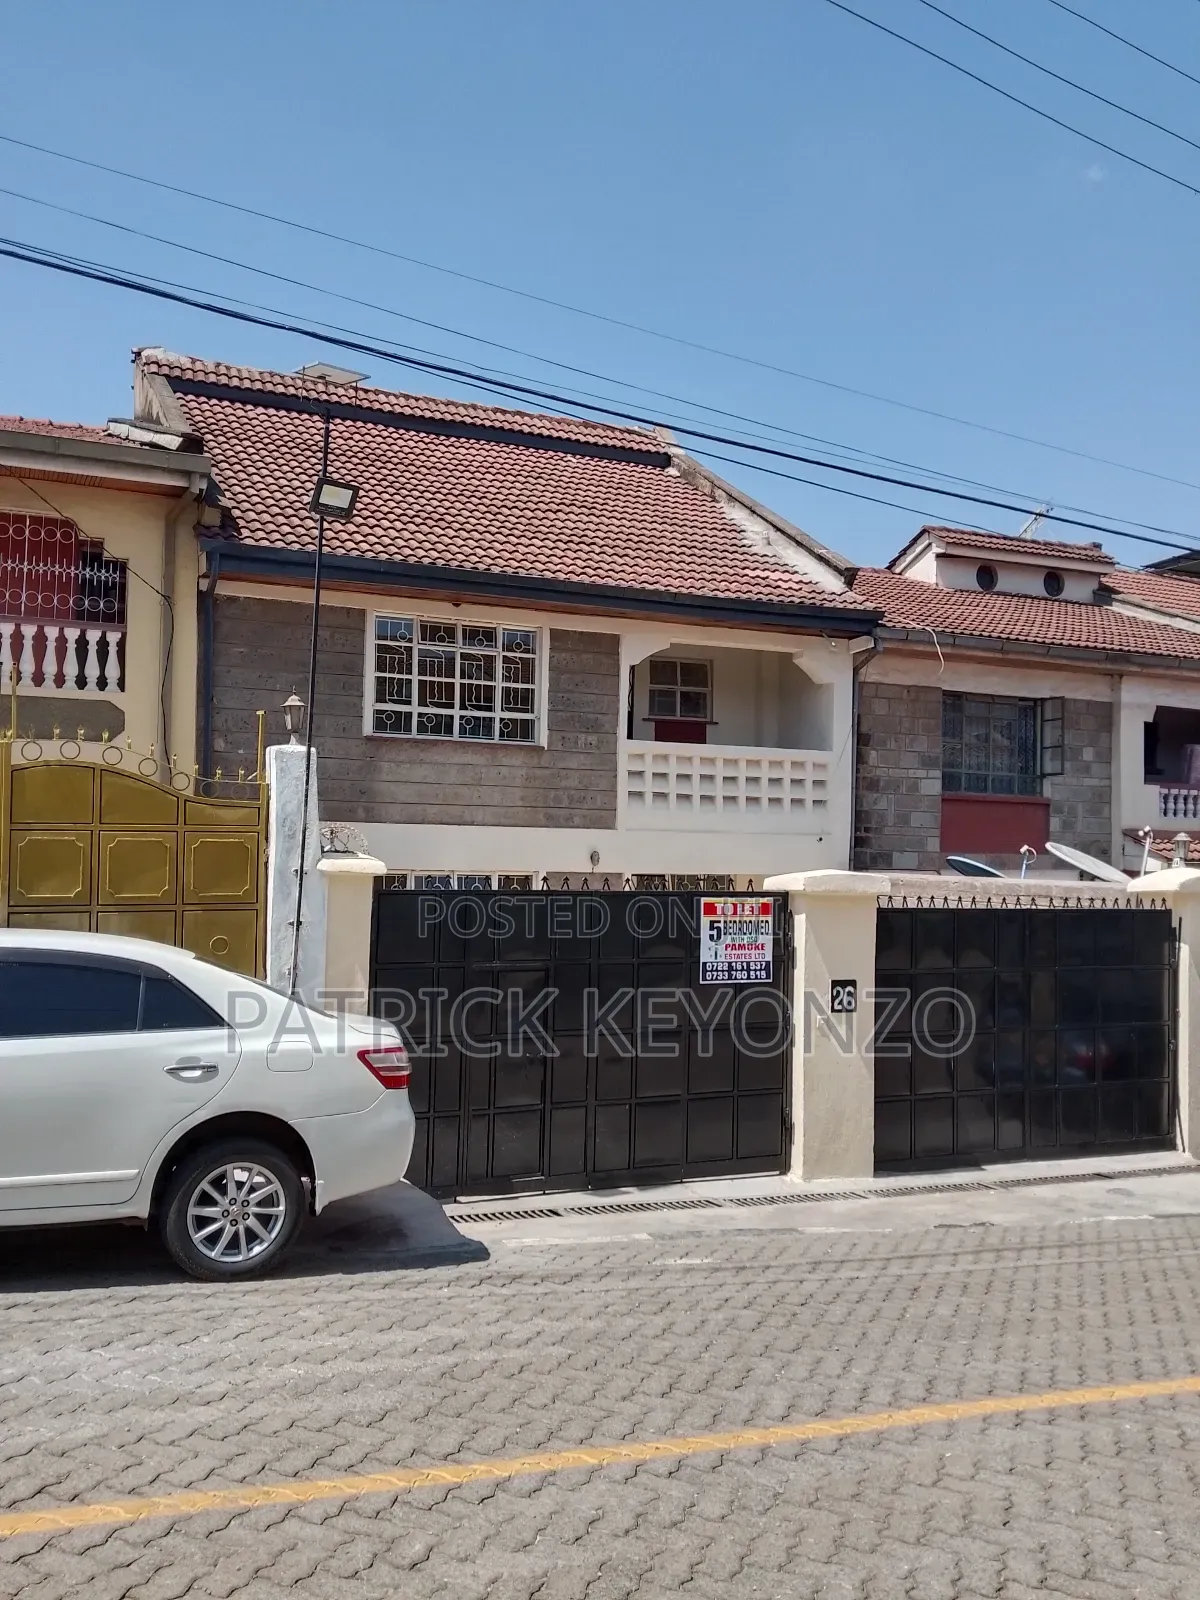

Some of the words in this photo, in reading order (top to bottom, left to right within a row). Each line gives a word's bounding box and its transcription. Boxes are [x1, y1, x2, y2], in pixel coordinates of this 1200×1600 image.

[715, 903, 735, 915] TO
[736, 903, 762, 915] LET
[709, 920, 722, 942] 5
[723, 920, 770, 936] BEDROOMED
[725, 943, 766, 951] PAMOKE
[754, 952, 766, 960] LTD
[706, 962, 729, 971] 0722
[731, 962, 747, 970] 161
[749, 961, 766, 970] 537
[706, 971, 729, 980] 0733
[731, 971, 748, 979] 760
[749, 970, 766, 979] 515
[832, 985, 855, 1010] 26
